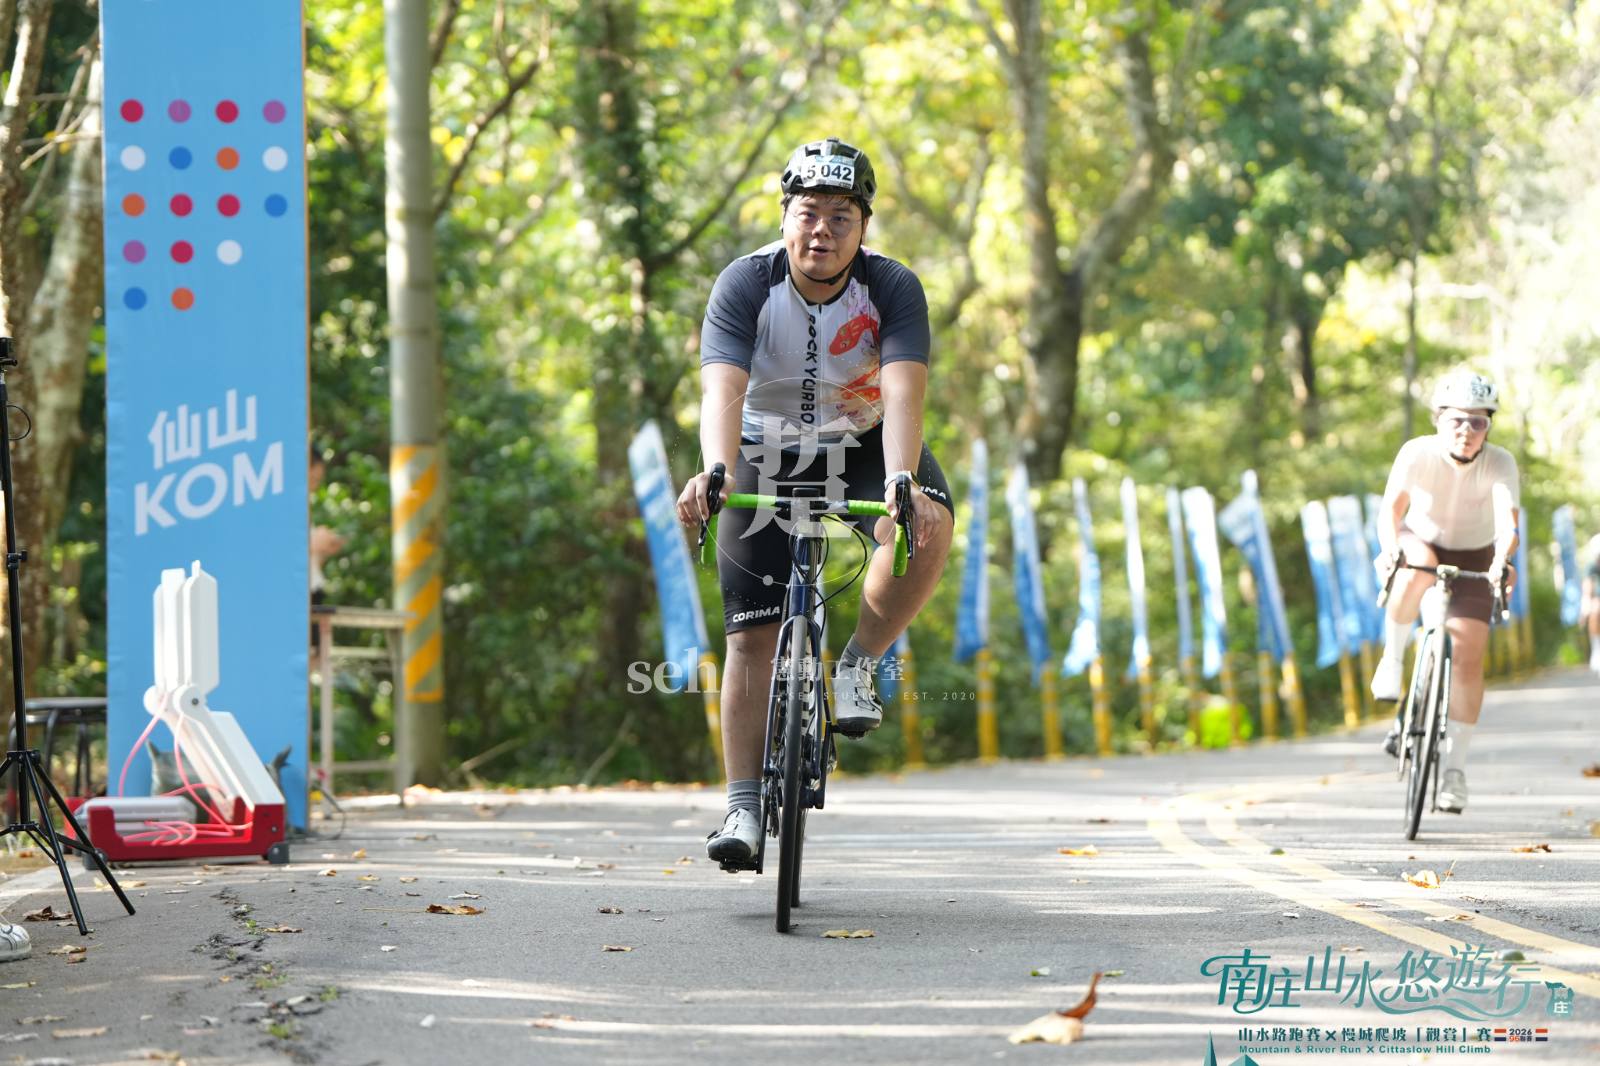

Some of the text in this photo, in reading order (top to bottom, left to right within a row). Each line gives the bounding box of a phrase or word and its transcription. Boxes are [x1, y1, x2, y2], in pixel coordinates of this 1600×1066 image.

[148, 389, 257, 471] 仙山
[134, 441, 284, 536] KOM
[920, 485, 946, 501] IMA
[732, 606, 780, 623] CORIMA
